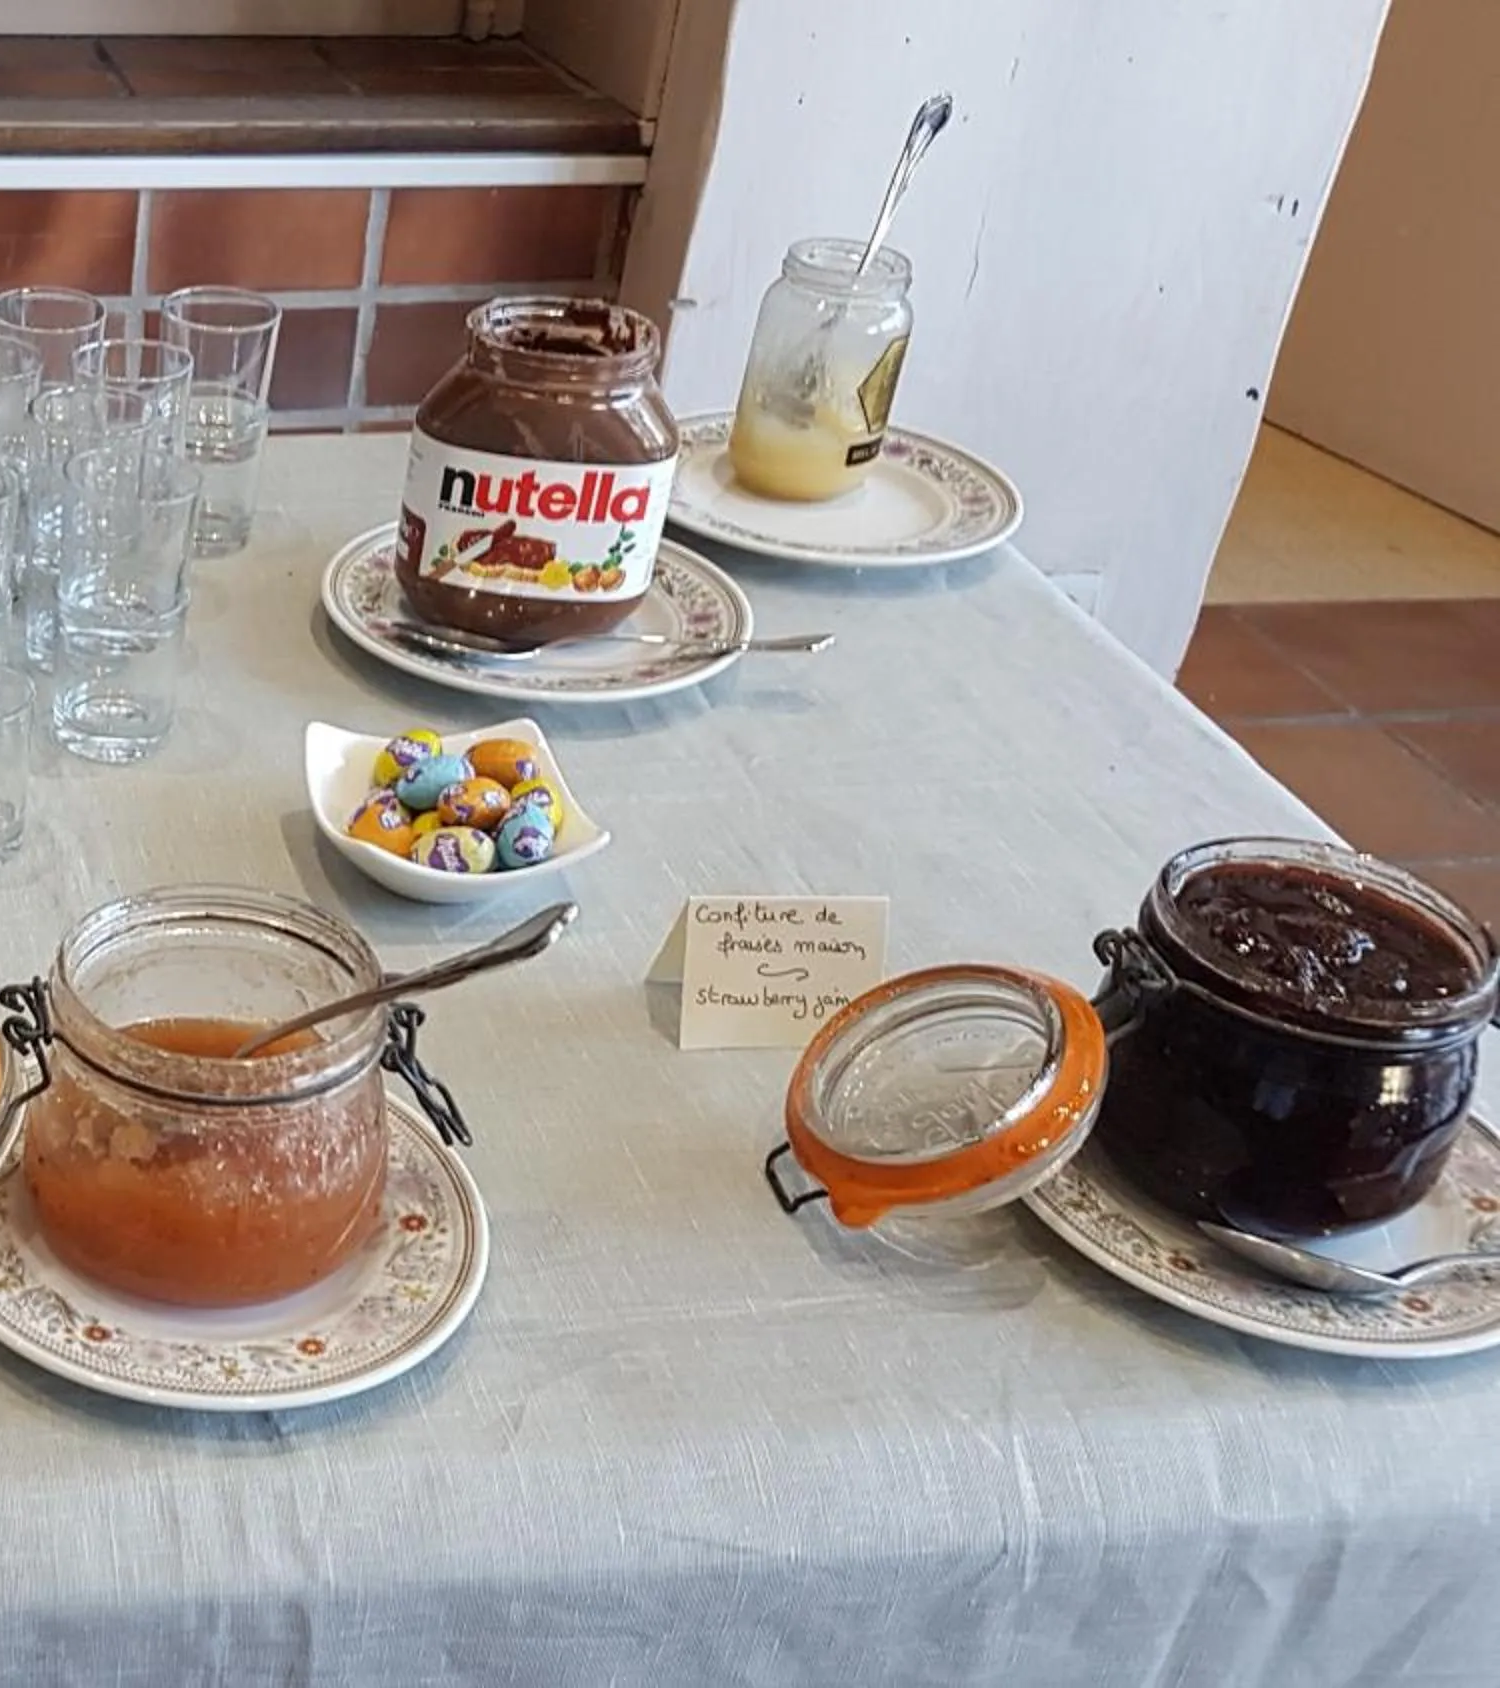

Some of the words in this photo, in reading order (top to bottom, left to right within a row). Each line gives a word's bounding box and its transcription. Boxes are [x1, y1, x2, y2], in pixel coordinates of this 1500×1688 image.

[439, 465, 650, 524] nutella
[695, 902, 804, 931] Confiture
[815, 904, 844, 925] de
